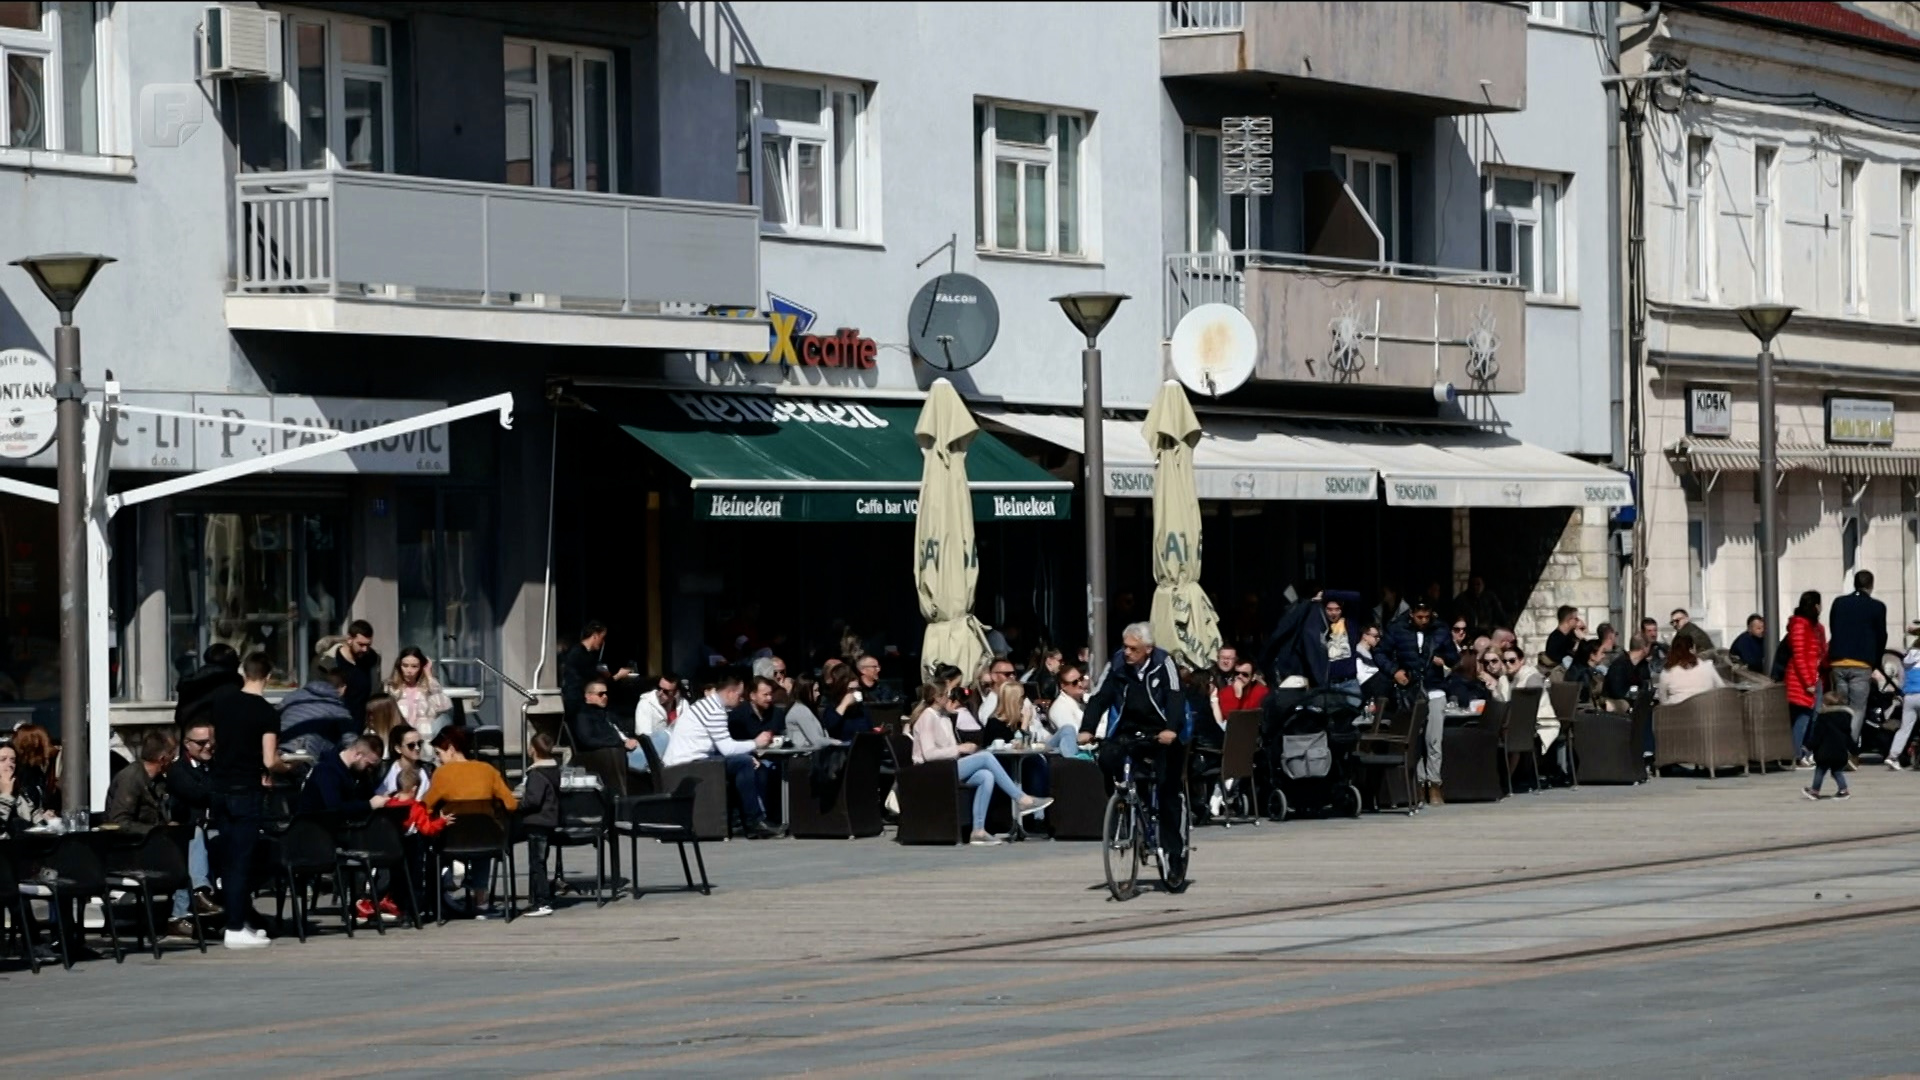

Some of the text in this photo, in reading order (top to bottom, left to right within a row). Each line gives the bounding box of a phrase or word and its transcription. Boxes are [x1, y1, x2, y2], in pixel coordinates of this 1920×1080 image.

[802, 327, 877, 369] caffe
[0, 382, 53, 400] NTANA
[1697, 393, 1727, 411] KIOSK
[710, 494, 784, 517] Heineken
[856, 498, 919, 514] Caffe bar VO
[993, 495, 1056, 517] Heineken
